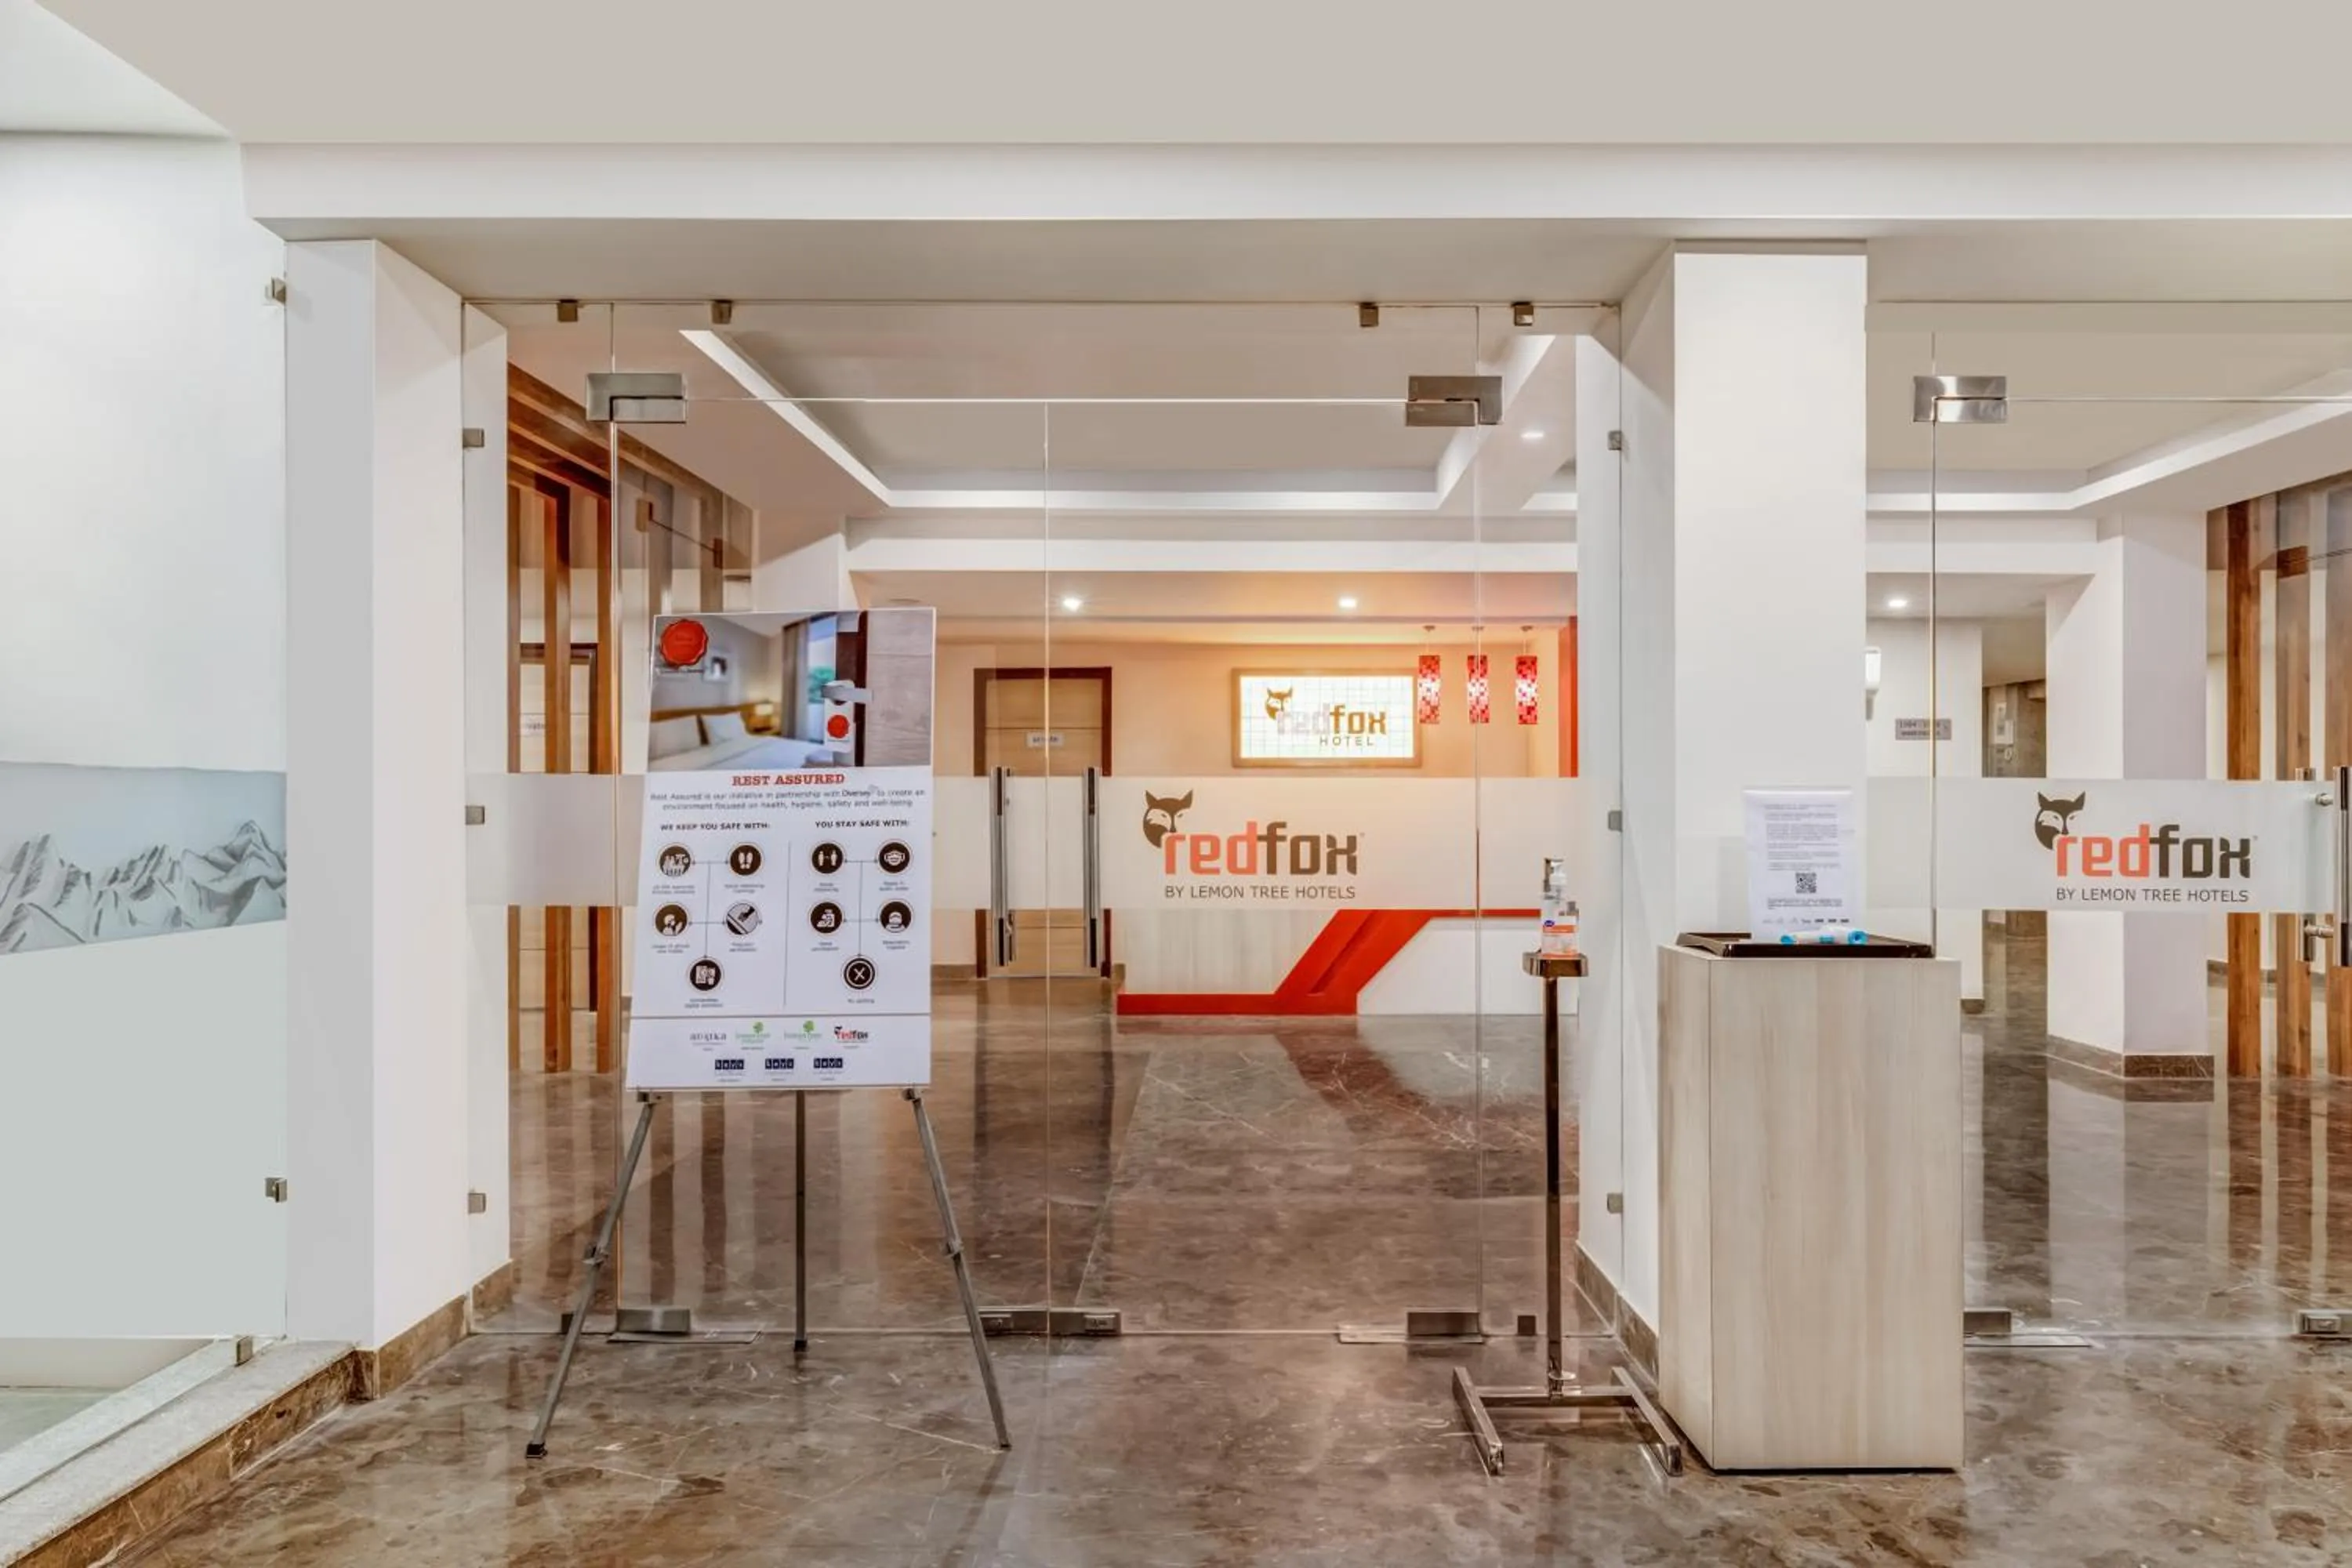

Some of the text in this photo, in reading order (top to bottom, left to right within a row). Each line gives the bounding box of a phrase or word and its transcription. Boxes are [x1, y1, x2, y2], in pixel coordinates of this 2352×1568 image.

[1276, 702, 1387, 735] redfox
[1319, 736, 1374, 746] HOTEL
[732, 774, 844, 786] REST ASSURED
[775, 790, 820, 799] partnership
[1165, 822, 1357, 875] redfox
[2056, 823, 2250, 878] redfox
[1166, 885, 1356, 899] BY LEMON TREE HOTELS
[2056, 887, 2249, 902] BY LEMON TREE HOTELS
